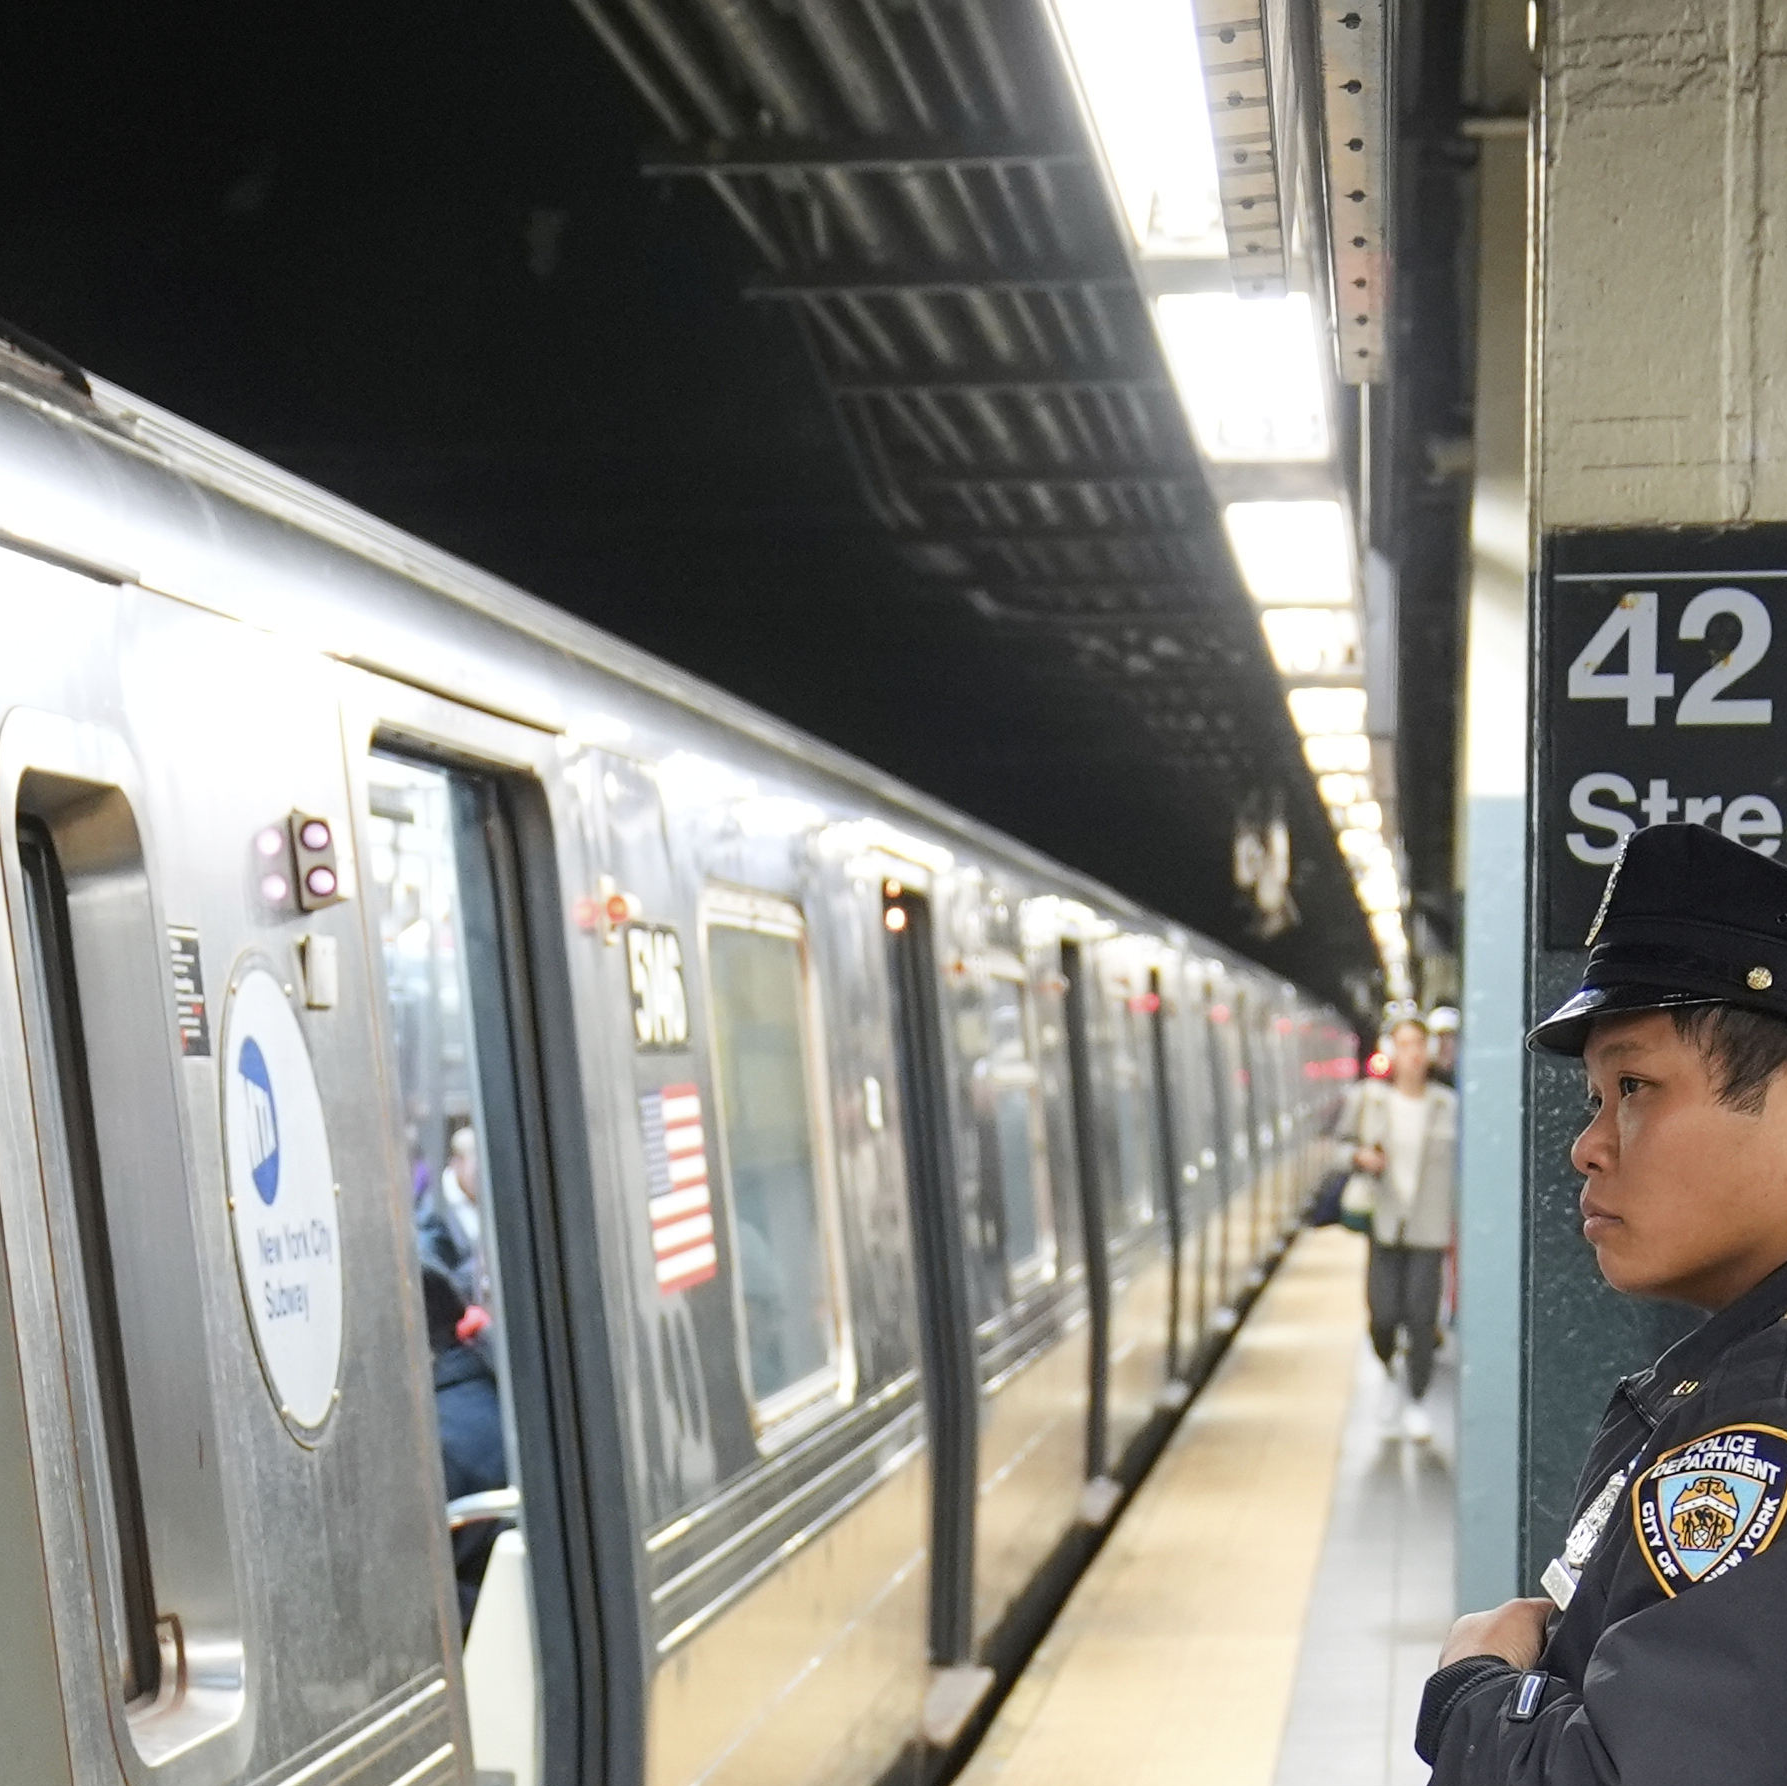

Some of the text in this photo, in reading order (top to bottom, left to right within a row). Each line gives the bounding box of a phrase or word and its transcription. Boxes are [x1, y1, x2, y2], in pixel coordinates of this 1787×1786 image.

[1567, 586, 1774, 727] 42
[257, 1219, 332, 1266] New York City
[264, 1277, 310, 1323] Subway
[1650, 1452, 1781, 1485] DEPARTMENT
[1684, 1434, 1757, 1456] POLICE
[1641, 1501, 1679, 1578] CITY OF
[1737, 1497, 1780, 1549] YORK
